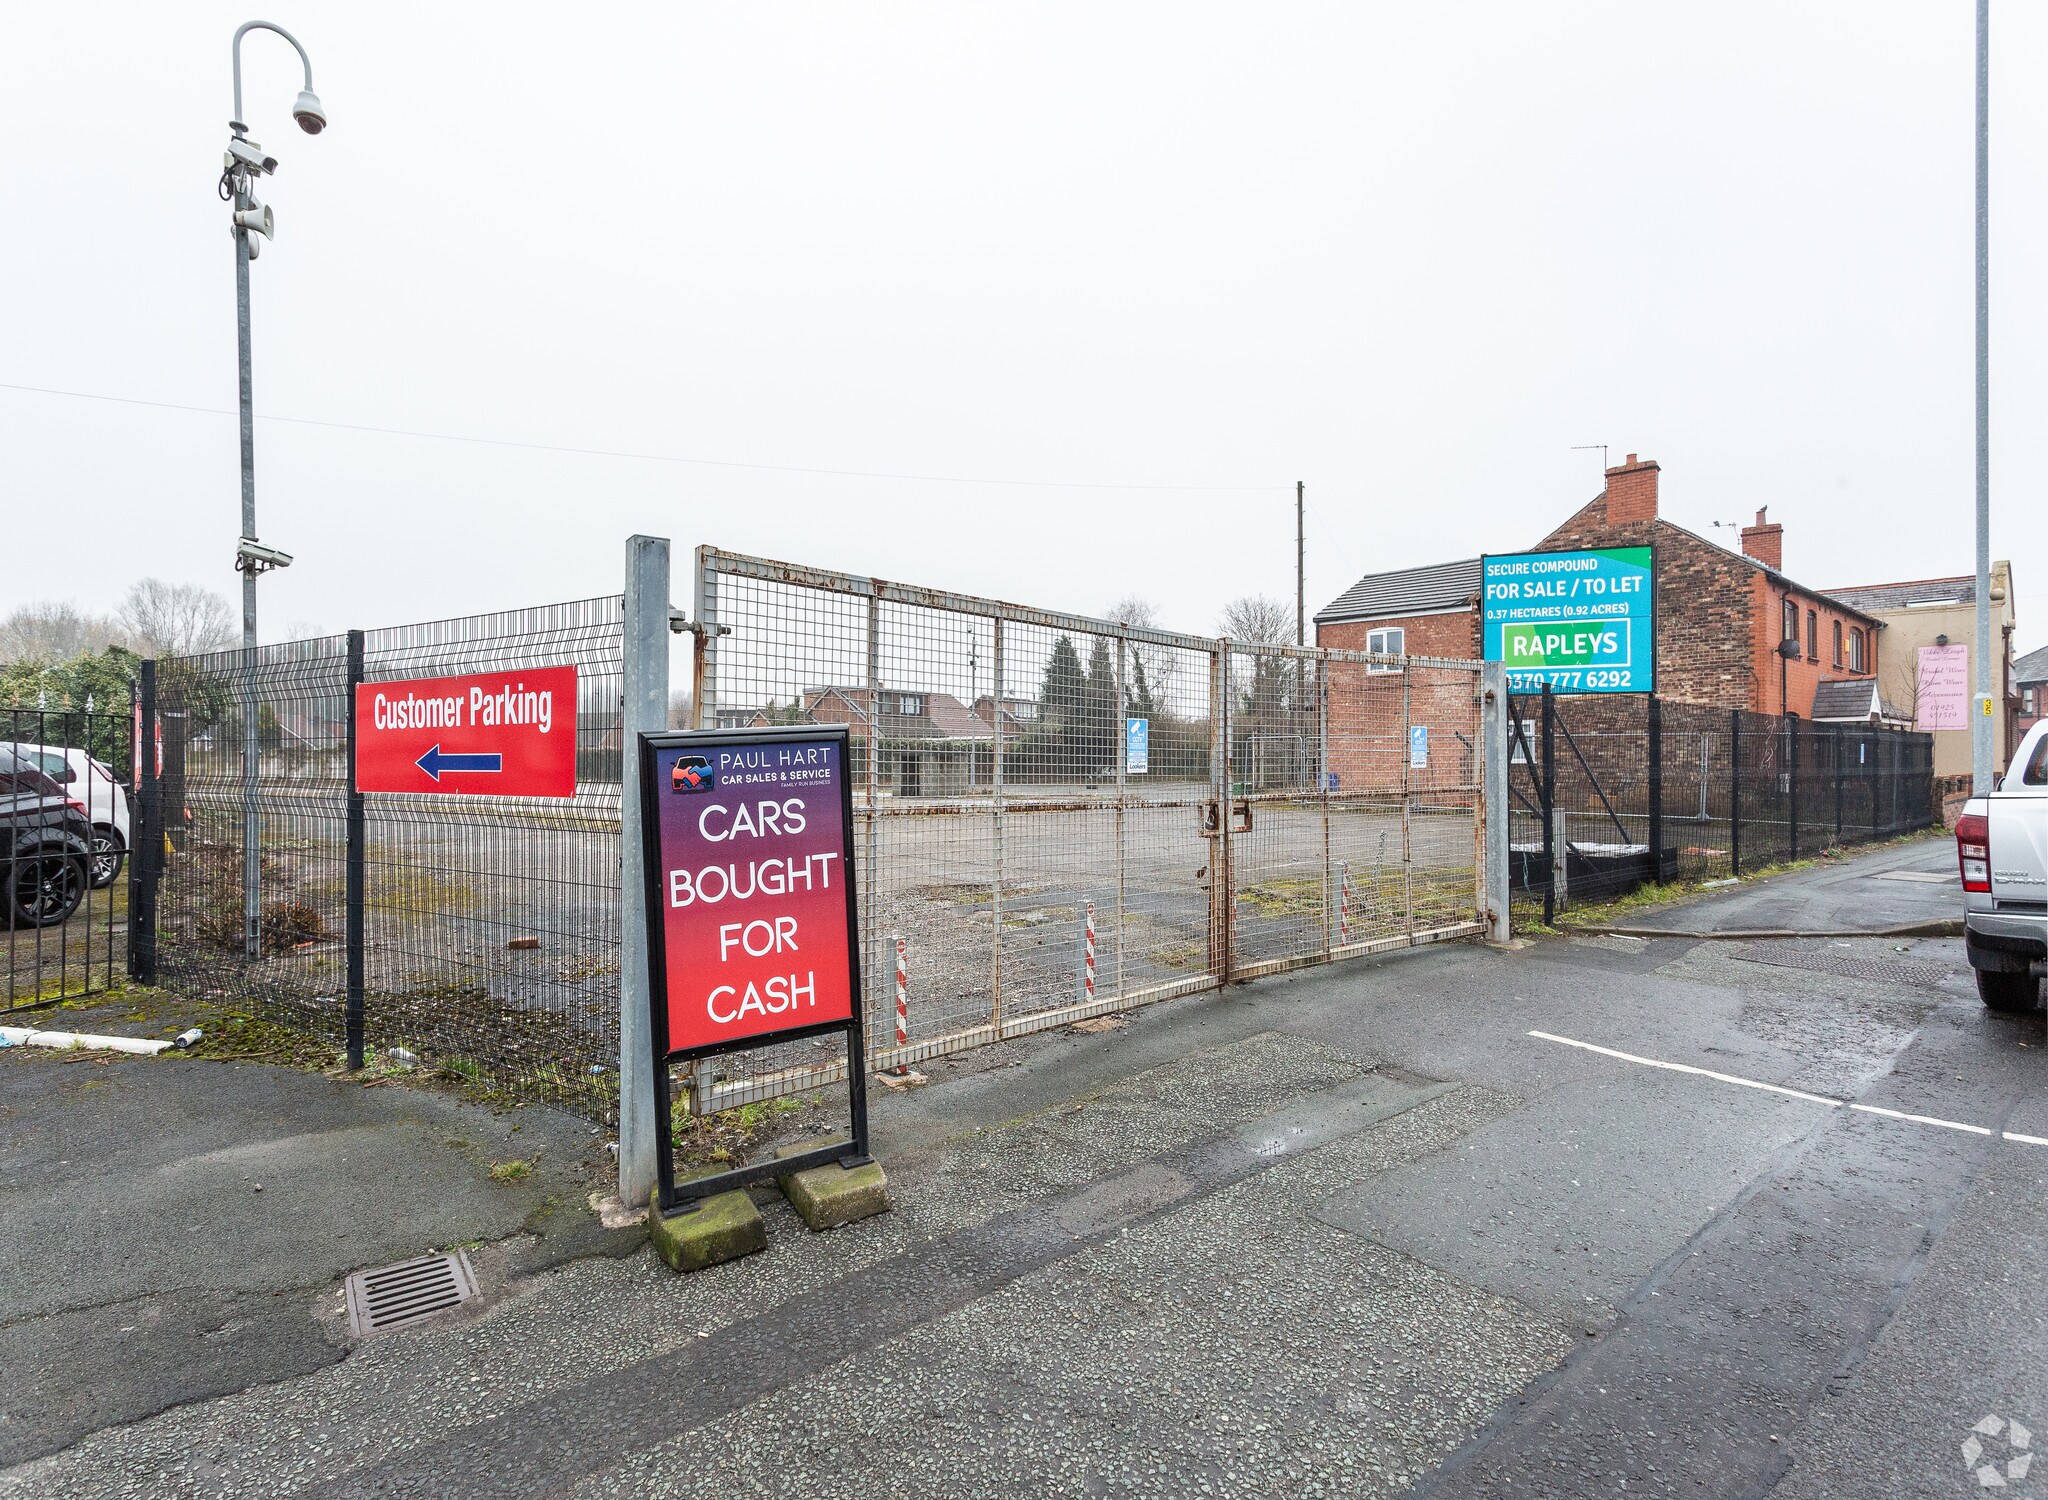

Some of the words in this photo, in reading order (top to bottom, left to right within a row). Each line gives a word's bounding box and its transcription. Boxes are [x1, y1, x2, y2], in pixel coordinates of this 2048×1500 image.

[1487, 563, 1529, 576] SECURE
[1532, 559, 1598, 573] COMPOUND
[1487, 584, 1520, 600] FOR
[1524, 581, 1566, 598] SALE
[1570, 578, 1580, 597] /
[1583, 579, 1606, 595] TO
[1611, 576, 1643, 593] LET
[1487, 610, 1507, 619] 0.37
[1509, 606, 1560, 618] HECTARES
[1563, 605, 1588, 617] (0.92
[1591, 602, 1629, 615] ACRES)
[1513, 632, 1618, 656] RAPLEYS
[1549, 672, 1581, 688] 777
[1586, 671, 1631, 687] 6292
[374, 692, 464, 730] Customer
[470, 683, 552, 734] Parking
[720, 751, 771, 770] PAUL
[779, 747, 831, 766] HART
[721, 775, 743, 785] CAR
[745, 772, 778, 783] SALES
[780, 772, 787, 781] &
[789, 769, 831, 780] SERVICE
[698, 798, 806, 842] CARS
[670, 852, 838, 908] BOUGHT
[1994, 877, 2047, 885] D-MAX
[719, 916, 799, 962] FOR
[707, 971, 815, 1024] CASH
